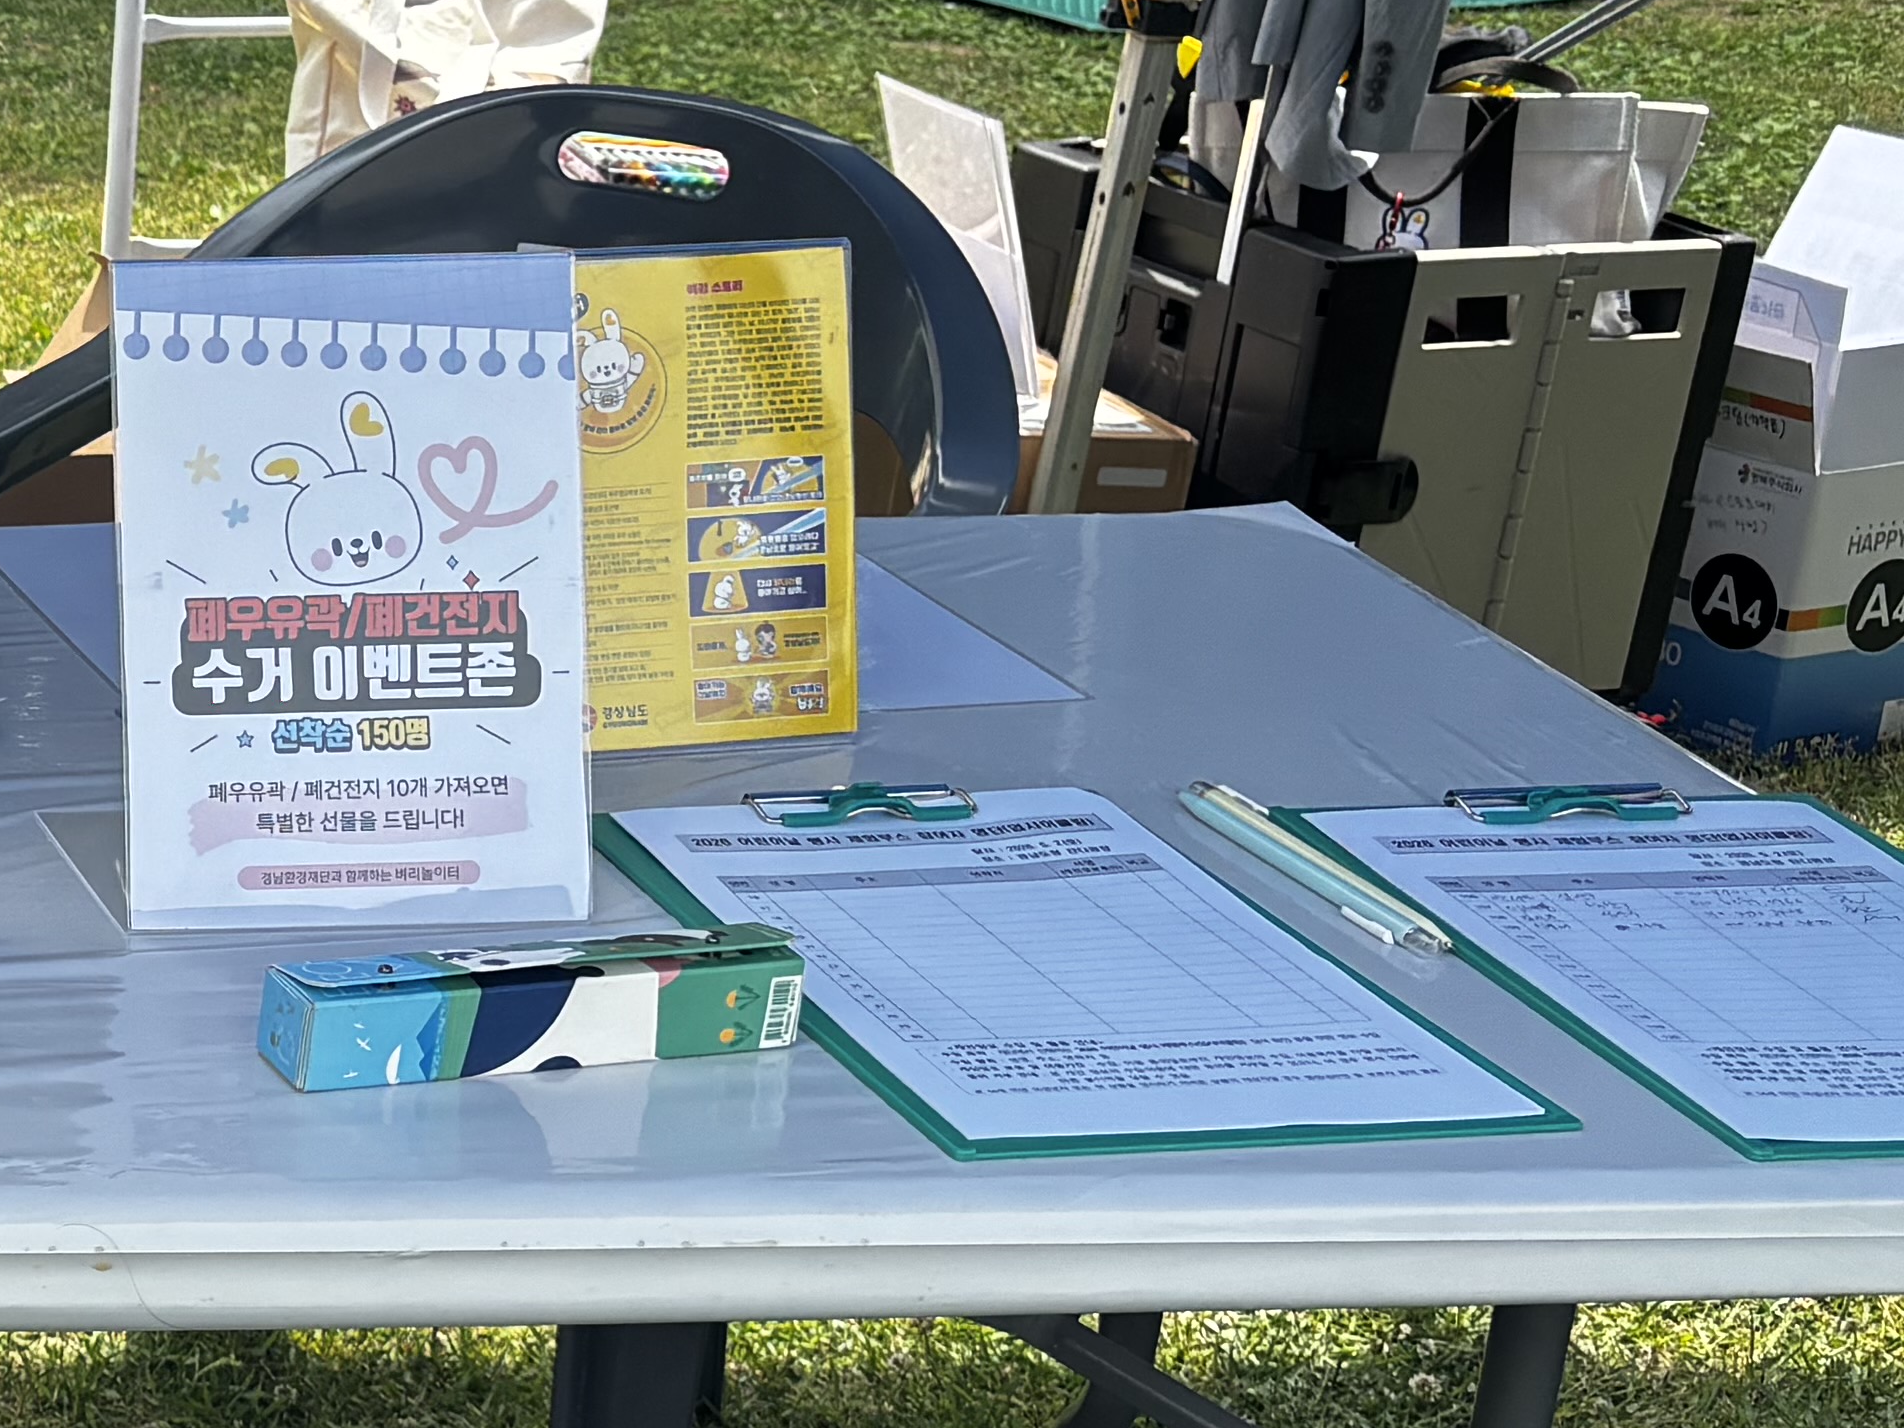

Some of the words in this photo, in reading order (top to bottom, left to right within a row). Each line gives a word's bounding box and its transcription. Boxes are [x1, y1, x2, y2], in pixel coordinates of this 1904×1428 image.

[185, 590, 520, 642] 폐우유곽/폐건전지
[1702, 574, 1763, 631] A4
[191, 646, 294, 704] 수거
[312, 641, 518, 702] 이벤트존
[602, 703, 649, 721] 경상남도
[272, 717, 353, 754] 선착순
[357, 715, 432, 752] 150명
[207, 780, 284, 803] 폐우유곽
[304, 778, 381, 801] 폐건전지
[386, 778, 429, 799] 10개
[433, 774, 510, 798] 가져오면
[256, 811, 315, 834] 특별한
[319, 809, 378, 833] 선물을
[382, 807, 466, 831] 드립니다!
